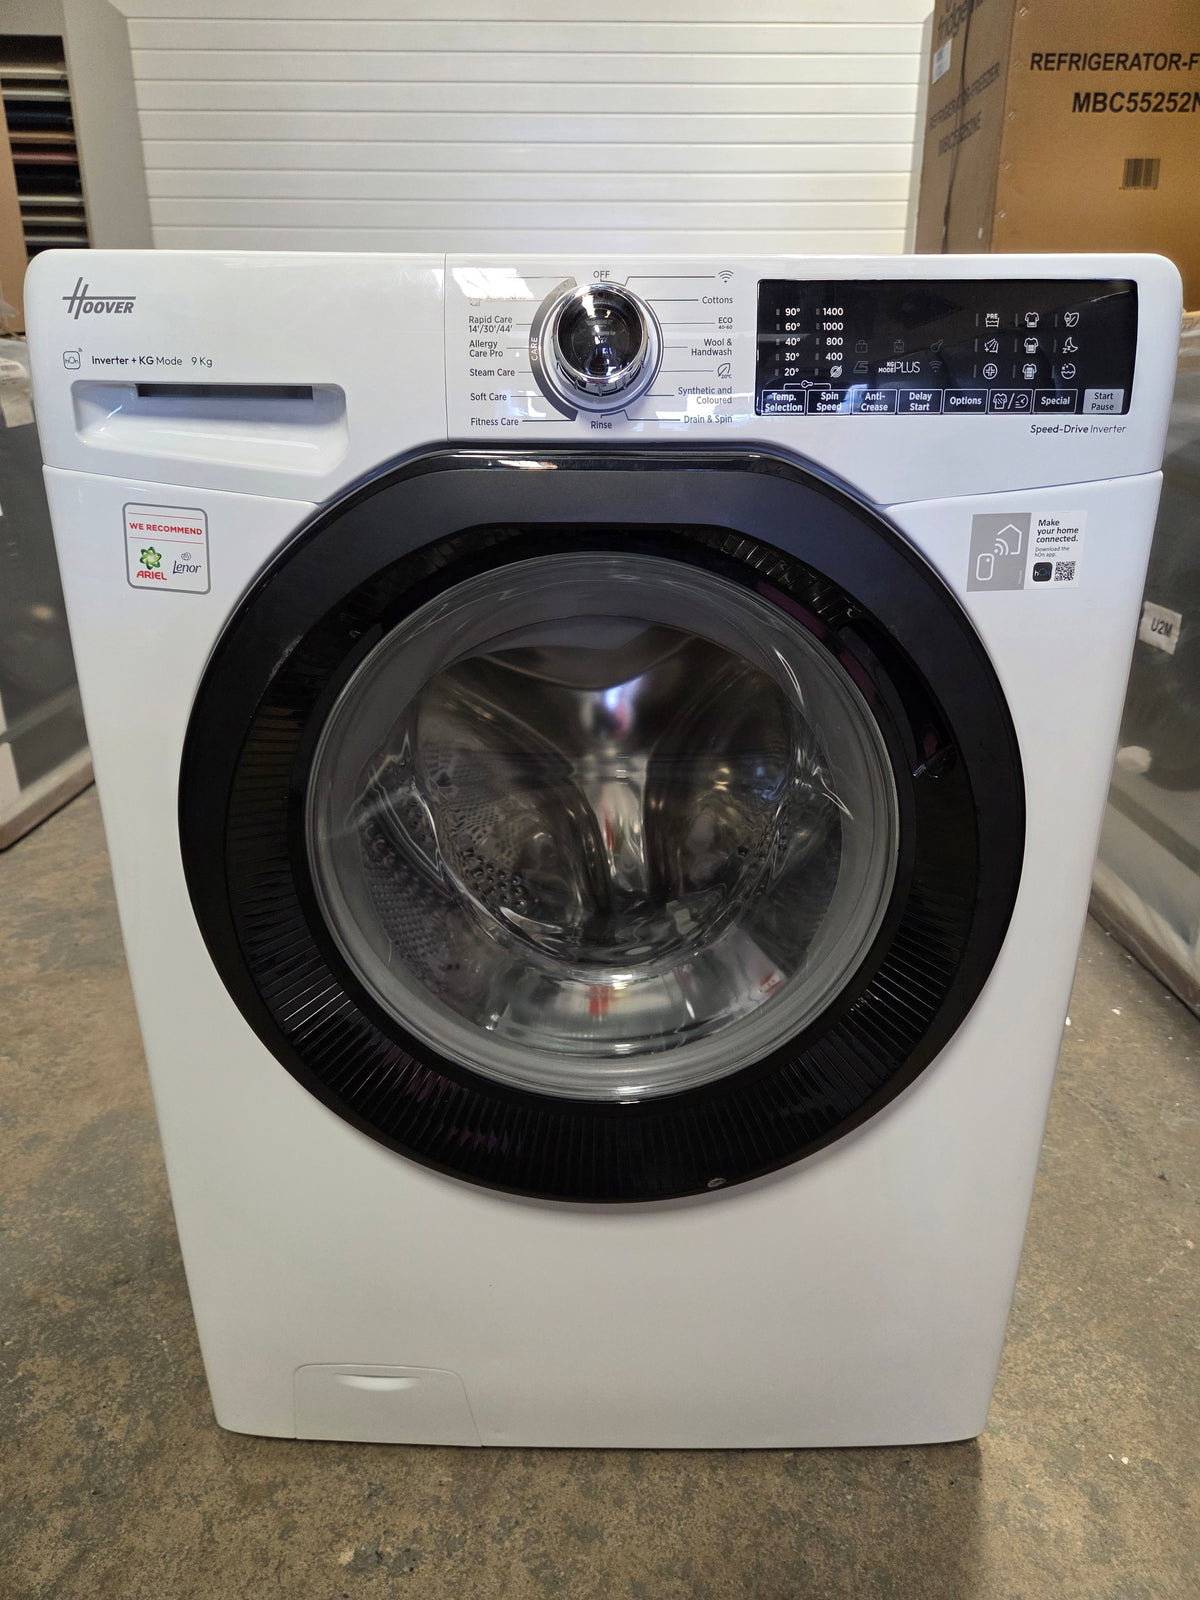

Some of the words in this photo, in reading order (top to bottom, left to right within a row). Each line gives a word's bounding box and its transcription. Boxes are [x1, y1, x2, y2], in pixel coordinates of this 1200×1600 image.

[593, 270, 610, 279] OFF
[62, 276, 137, 320] HOOVER
[702, 295, 734, 304] Cottons
[822, 308, 844, 316] 1400
[468, 315, 492, 326] Rapid
[494, 315, 513, 324] Care
[718, 316, 733, 324] ECO
[468, 324, 513, 334] 14'/30'/44'
[822, 323, 844, 331] 1000
[469, 339, 498, 350] Allergy
[703, 338, 725, 347] Wool
[726, 338, 733, 347] &
[826, 337, 844, 346] 800
[469, 349, 488, 358] Care
[489, 349, 504, 358] Pro
[530, 336, 539, 361] CARE
[691, 347, 733, 357] Handwash
[91, 355, 129, 365] Inverter
[139, 356, 154, 365] KG
[156, 357, 183, 366] Mode
[191, 356, 198, 365] 9
[199, 357, 213, 368] Kg
[825, 352, 843, 361] 400
[894, 361, 920, 373] PLUS
[469, 368, 495, 377] Steam
[496, 368, 515, 377] Care
[470, 392, 487, 401] Soft
[488, 392, 507, 401] Care
[678, 386, 715, 397] Synthetic
[717, 386, 733, 395] and
[820, 391, 839, 402] Spin
[864, 392, 886, 401] Anti-
[1094, 392, 1114, 400] Start
[696, 396, 733, 405] Coloured
[772, 393, 797, 402] Temp.
[909, 392, 933, 402] Delay
[949, 396, 982, 406] Options
[1040, 396, 1071, 406] Special
[764, 402, 803, 412] Selection
[816, 403, 842, 413] Speed
[860, 403, 888, 412] Crease
[909, 403, 930, 411] Start
[1090, 403, 1114, 411] Pause
[470, 417, 498, 426] Fitness
[500, 417, 519, 426] Care
[683, 415, 706, 424] Drain
[706, 415, 713, 424] &
[714, 415, 733, 425] Spin
[590, 421, 612, 430] Rinse
[1030, 424, 1089, 435] Speed-Drive
[1090, 424, 1127, 434] Inverter
[1038, 518, 1060, 527] Make
[129, 522, 144, 531] WE
[146, 524, 203, 536] RECOMMEND
[1037, 527, 1055, 537] your
[1056, 526, 1079, 534] home
[1036, 534, 1079, 544] connected.
[172, 560, 202, 575] Lenor
[136, 570, 168, 581] ARIEL
